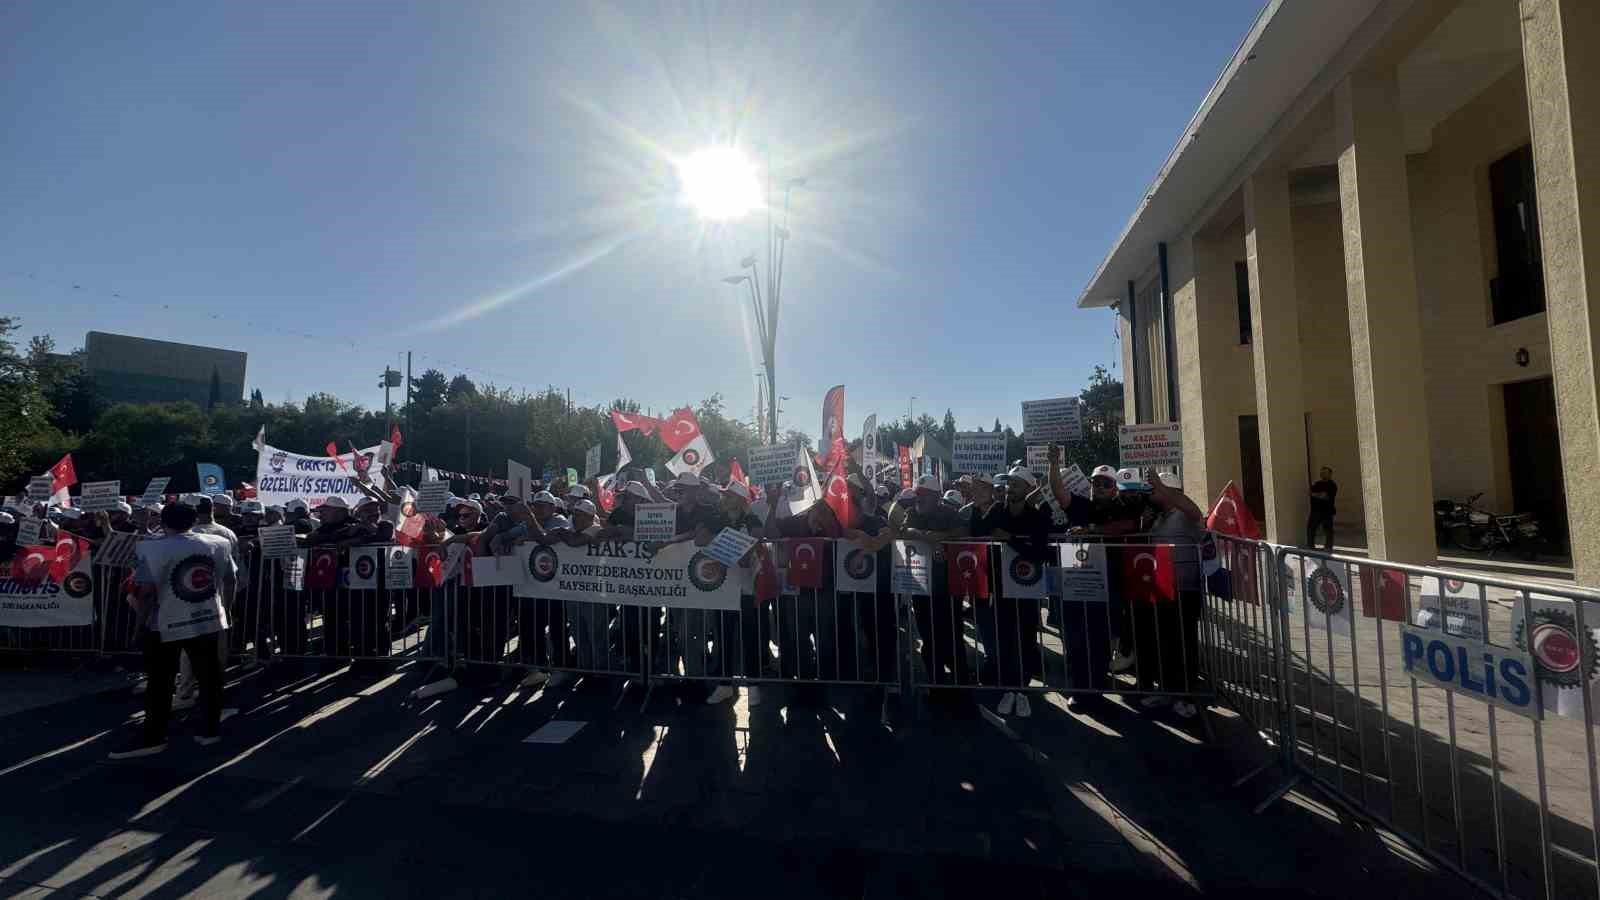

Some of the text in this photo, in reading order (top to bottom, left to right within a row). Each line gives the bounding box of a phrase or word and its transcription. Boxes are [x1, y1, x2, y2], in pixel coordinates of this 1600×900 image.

[561, 563, 683, 580] KONFEDERASYONU
[559, 579, 602, 594] KAYSERİ
[618, 583, 687, 599] BAŞKANLIĞI
